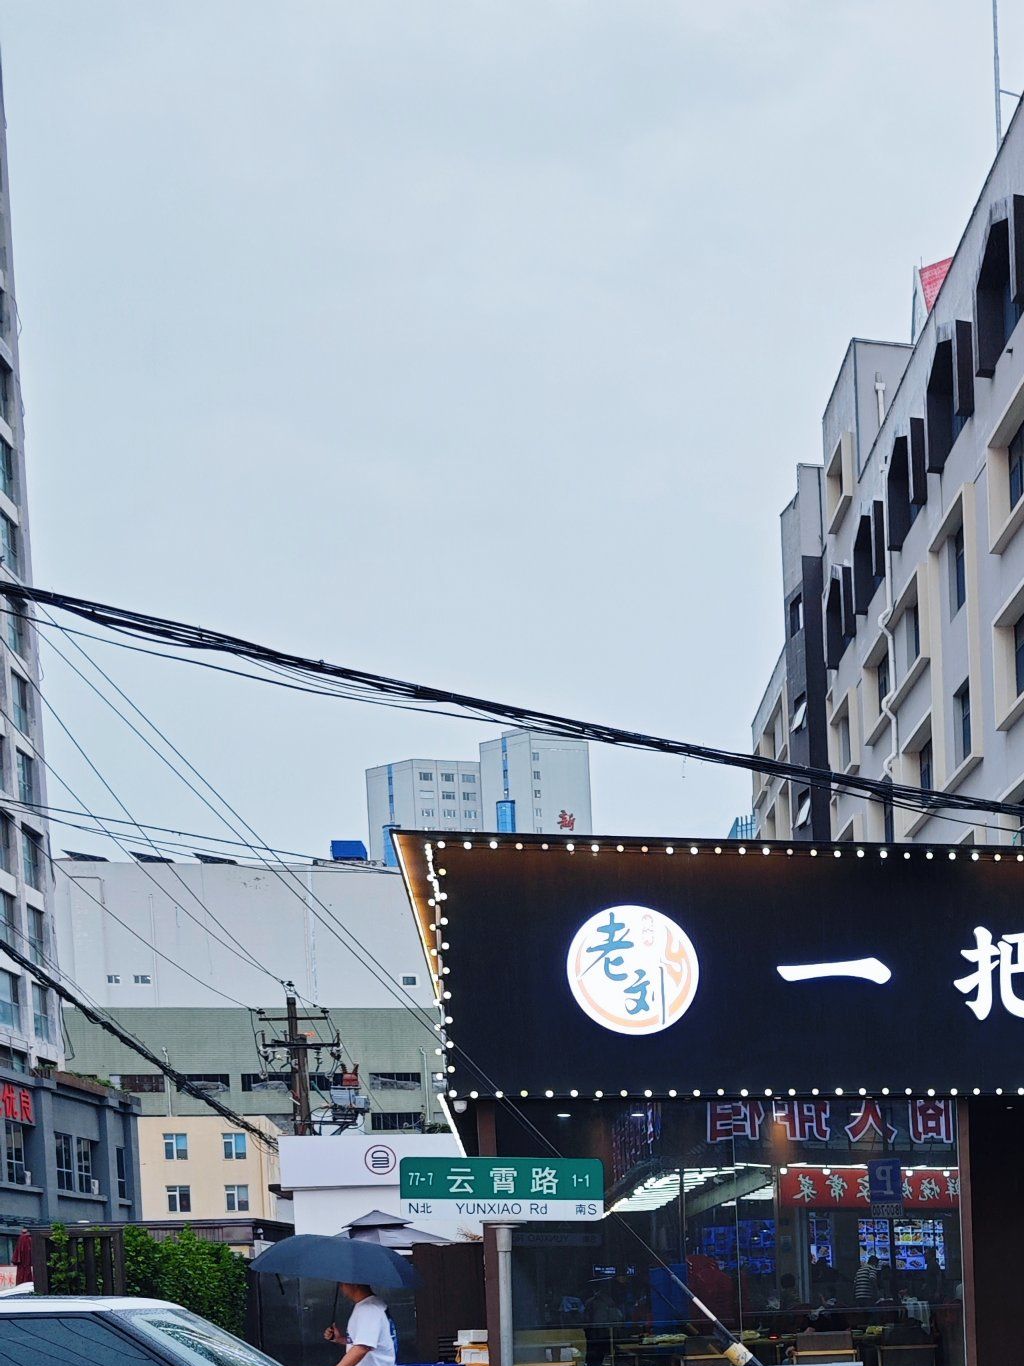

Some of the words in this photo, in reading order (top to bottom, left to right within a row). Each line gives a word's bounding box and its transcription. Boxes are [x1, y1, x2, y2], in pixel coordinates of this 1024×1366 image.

[0, 1081, 33, 1123] 优良
[408, 1172, 434, 1186] 77-7
[446, 1167, 560, 1195] 云霄路
[572, 1174, 590, 1188] 1-1
[455, 1203, 522, 1215] YUNXIAO
[530, 1203, 548, 1215] Rd
